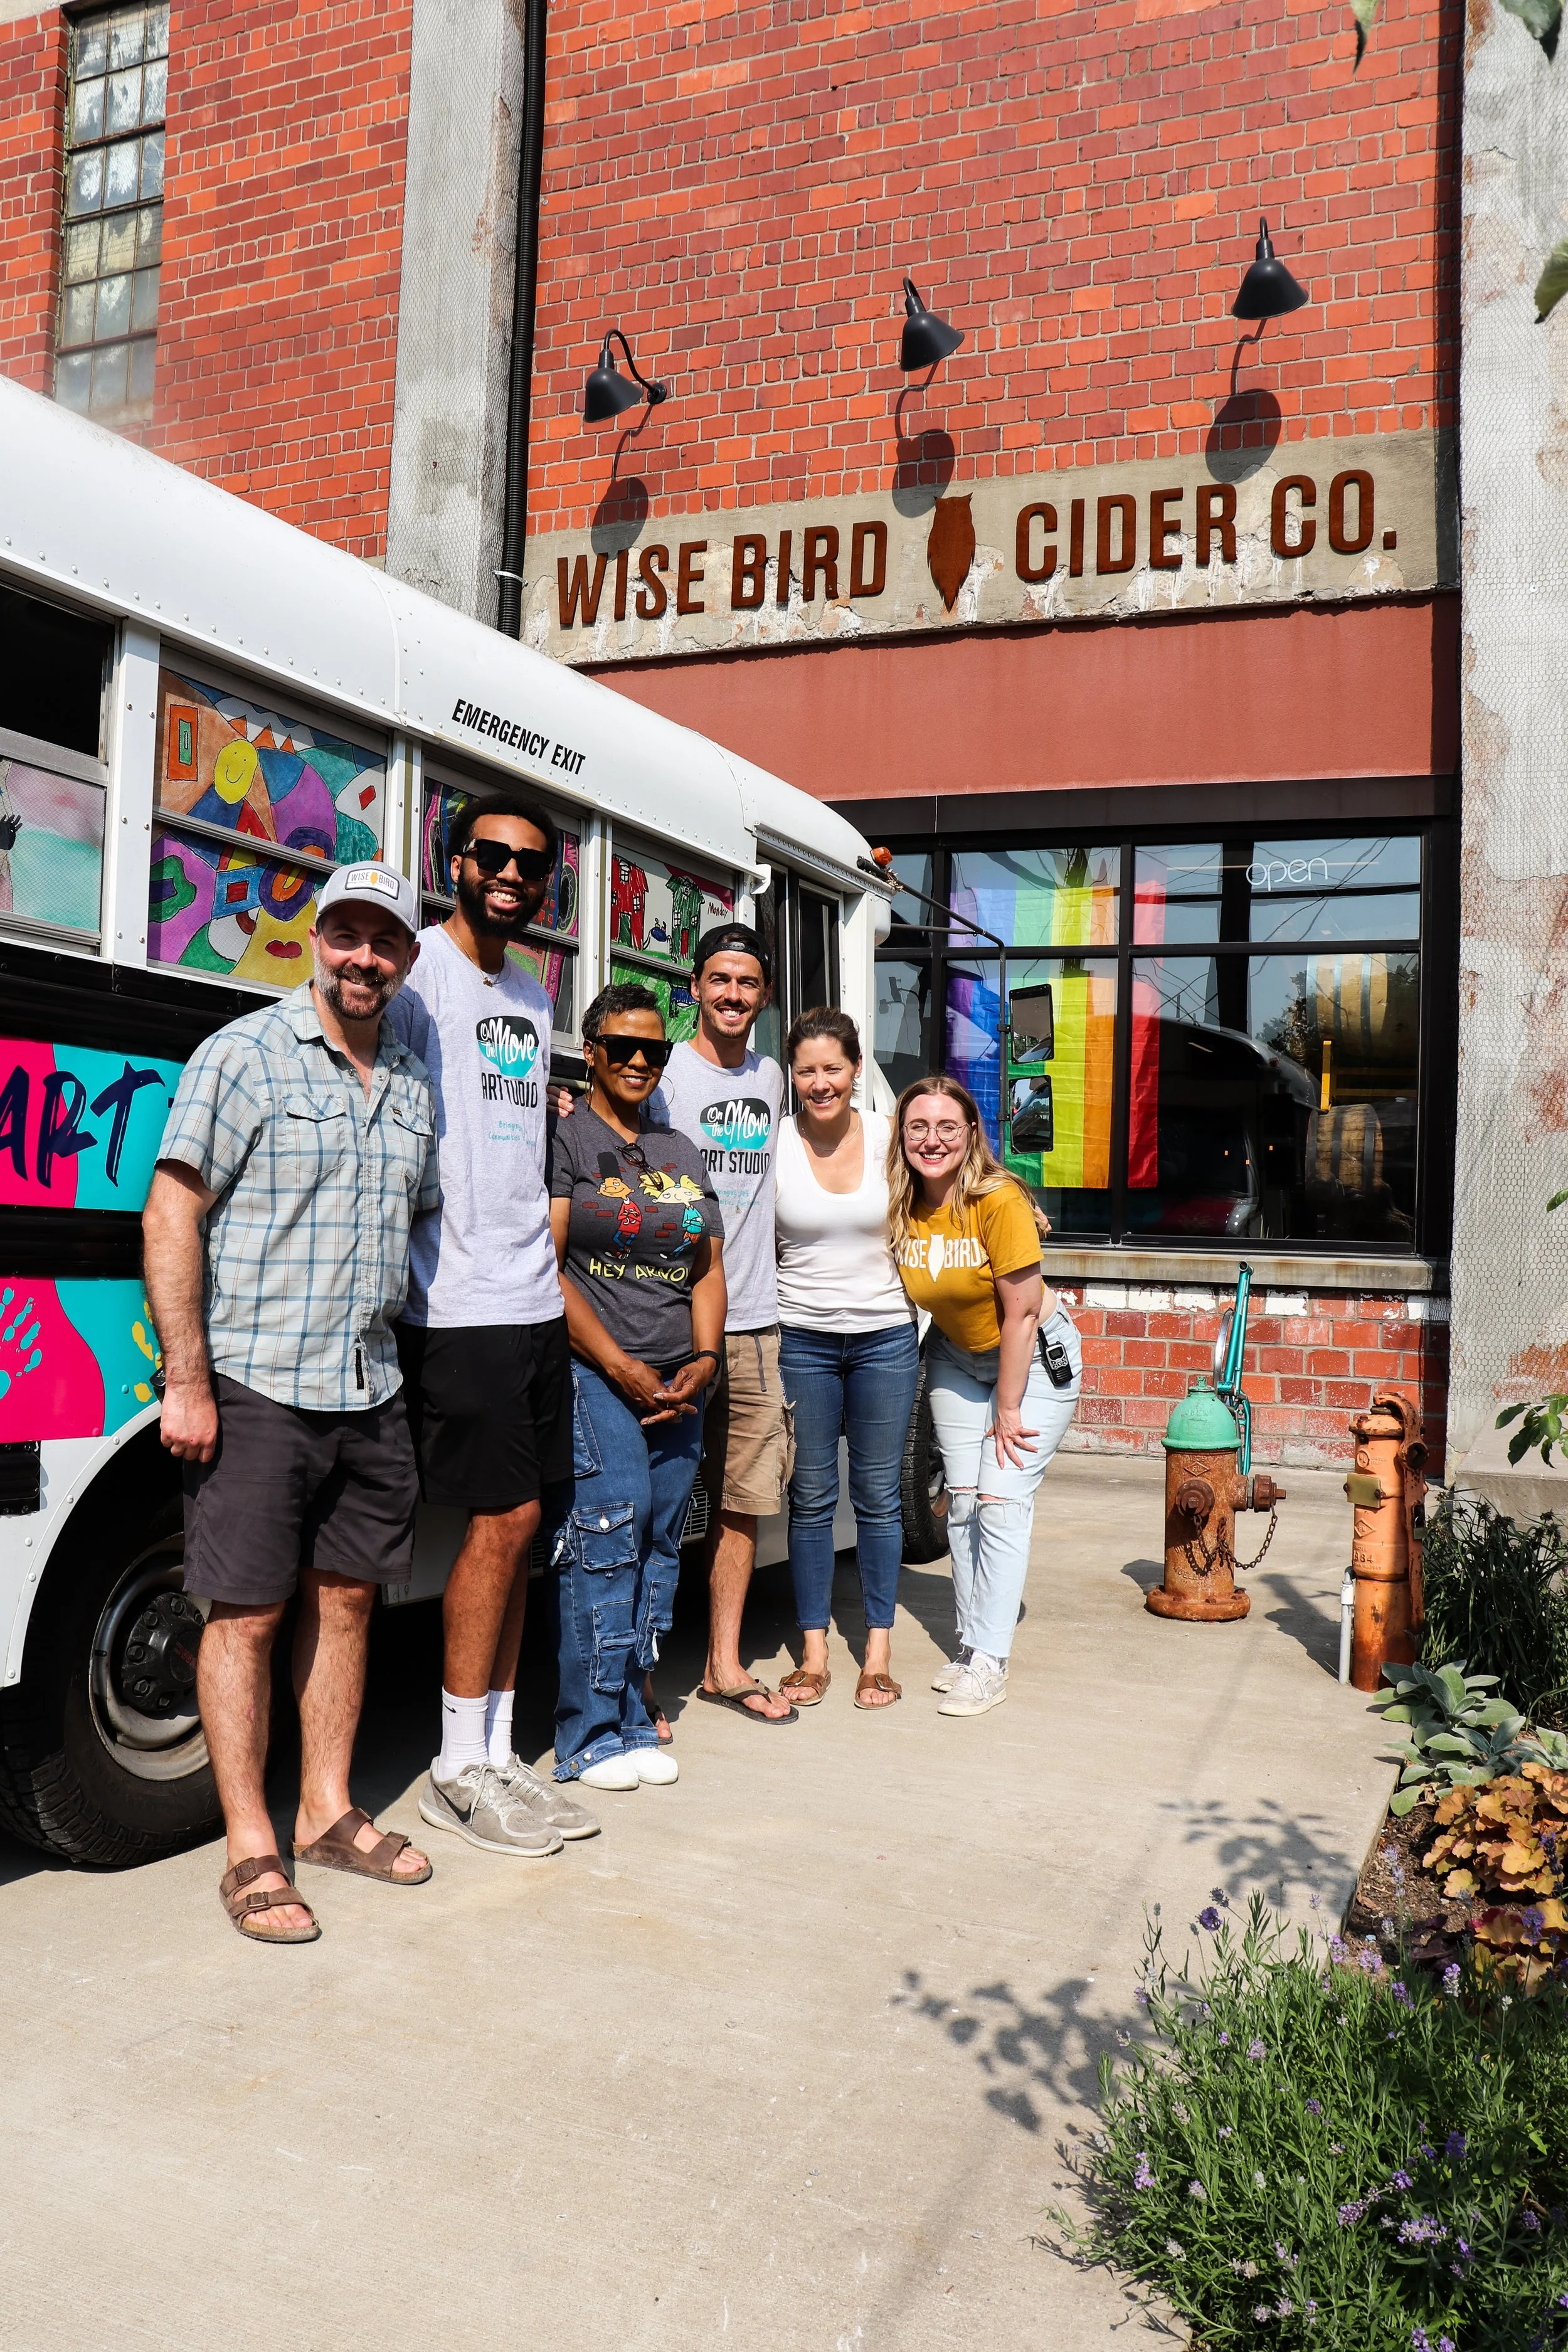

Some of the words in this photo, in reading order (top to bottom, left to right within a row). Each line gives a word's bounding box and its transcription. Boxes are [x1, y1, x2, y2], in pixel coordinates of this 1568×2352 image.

[557, 541, 707, 627] WISE
[731, 521, 888, 610] BIRD
[1015, 483, 1237, 581] CIDER
[1271, 469, 1397, 557] CO.
[452, 698, 550, 759] EMERGENCY
[551, 744, 586, 775] EXIT
[351, 872, 371, 881] WISE
[378, 875, 395, 889] BIRD
[1246, 857, 1328, 892] open
[489, 1017, 536, 1067] Move
[481, 1072, 504, 1101] ART
[504, 1079, 538, 1108] TUDIO
[0, 1060, 166, 1189] ART
[706, 1121, 724, 1137] the
[707, 1106, 723, 1123] On
[724, 1099, 770, 1145] Move
[729, 1152, 770, 1175] STUDIO
[589, 1258, 626, 1279] HEY
[635, 1264, 689, 1282] ARNO
[944, 1237, 982, 1269] BIRD
